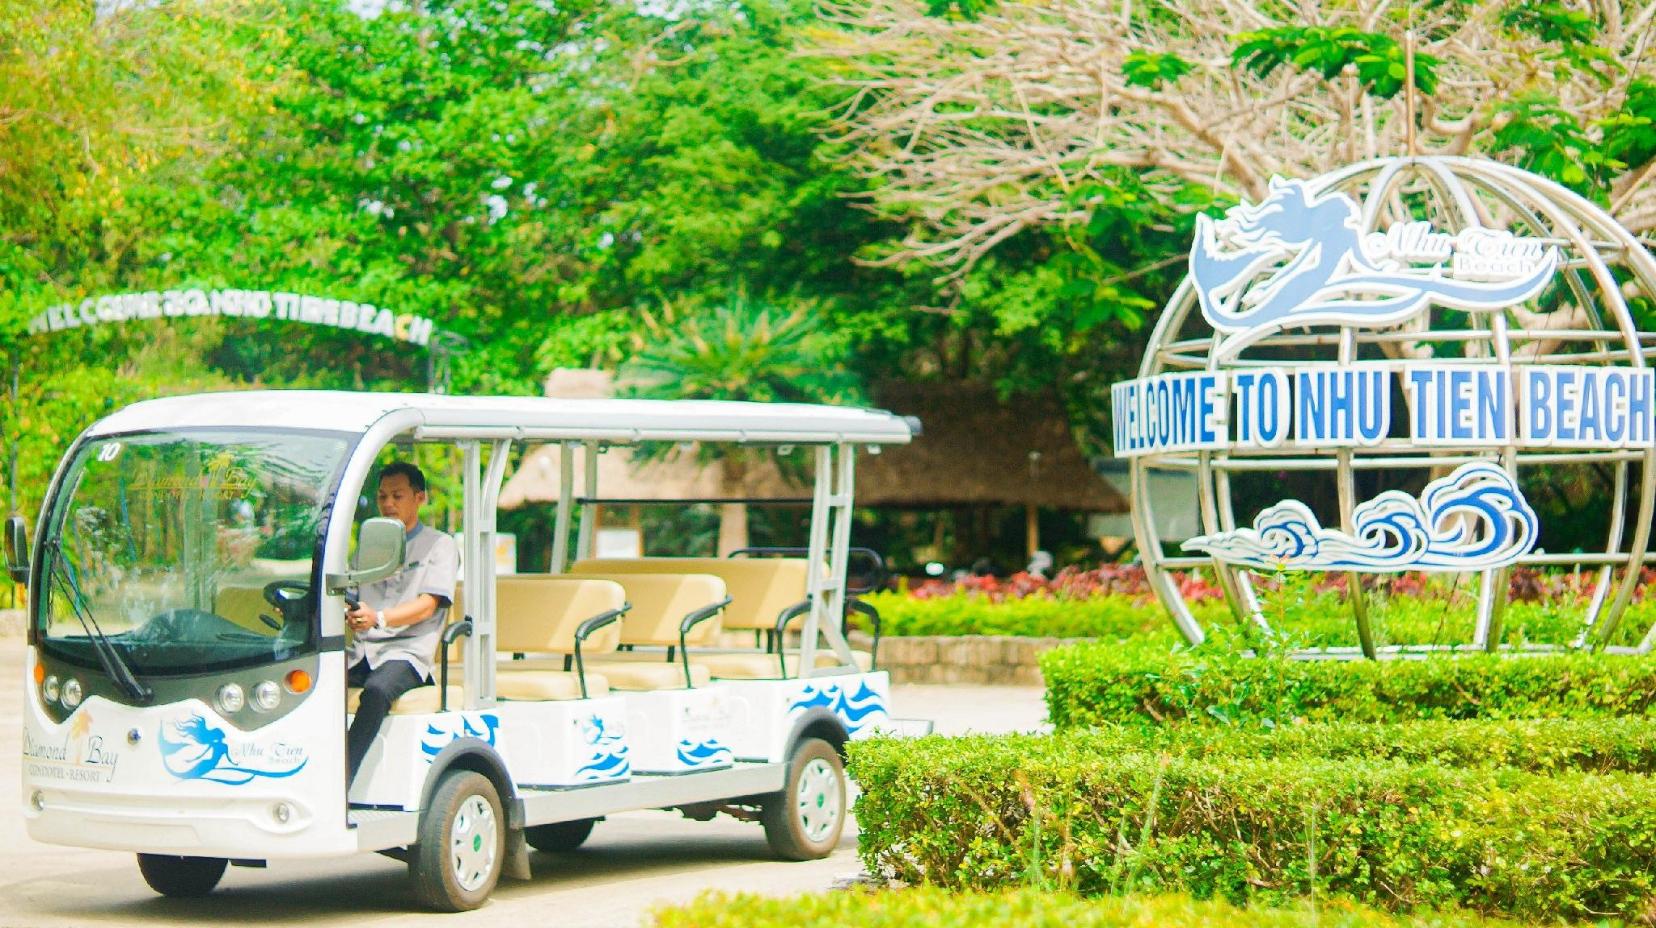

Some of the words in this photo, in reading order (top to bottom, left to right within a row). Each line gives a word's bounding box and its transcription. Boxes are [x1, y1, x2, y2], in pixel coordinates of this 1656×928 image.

[1366, 221, 1451, 258] Nhu
[1457, 227, 1543, 256] Tien
[1458, 256, 1536, 273] Beach
[28, 290, 161, 335] WELCOME
[338, 300, 433, 346] BEACH
[1113, 376, 1216, 451] WELCOME
[1237, 372, 1278, 442] TO
[1299, 371, 1383, 439] NHU
[1411, 370, 1505, 439] TIEN
[1529, 371, 1651, 442] BEACH
[98, 442, 121, 461] 10
[69, 768, 100, 783] RESORT
[85, 735, 119, 782] Bay
